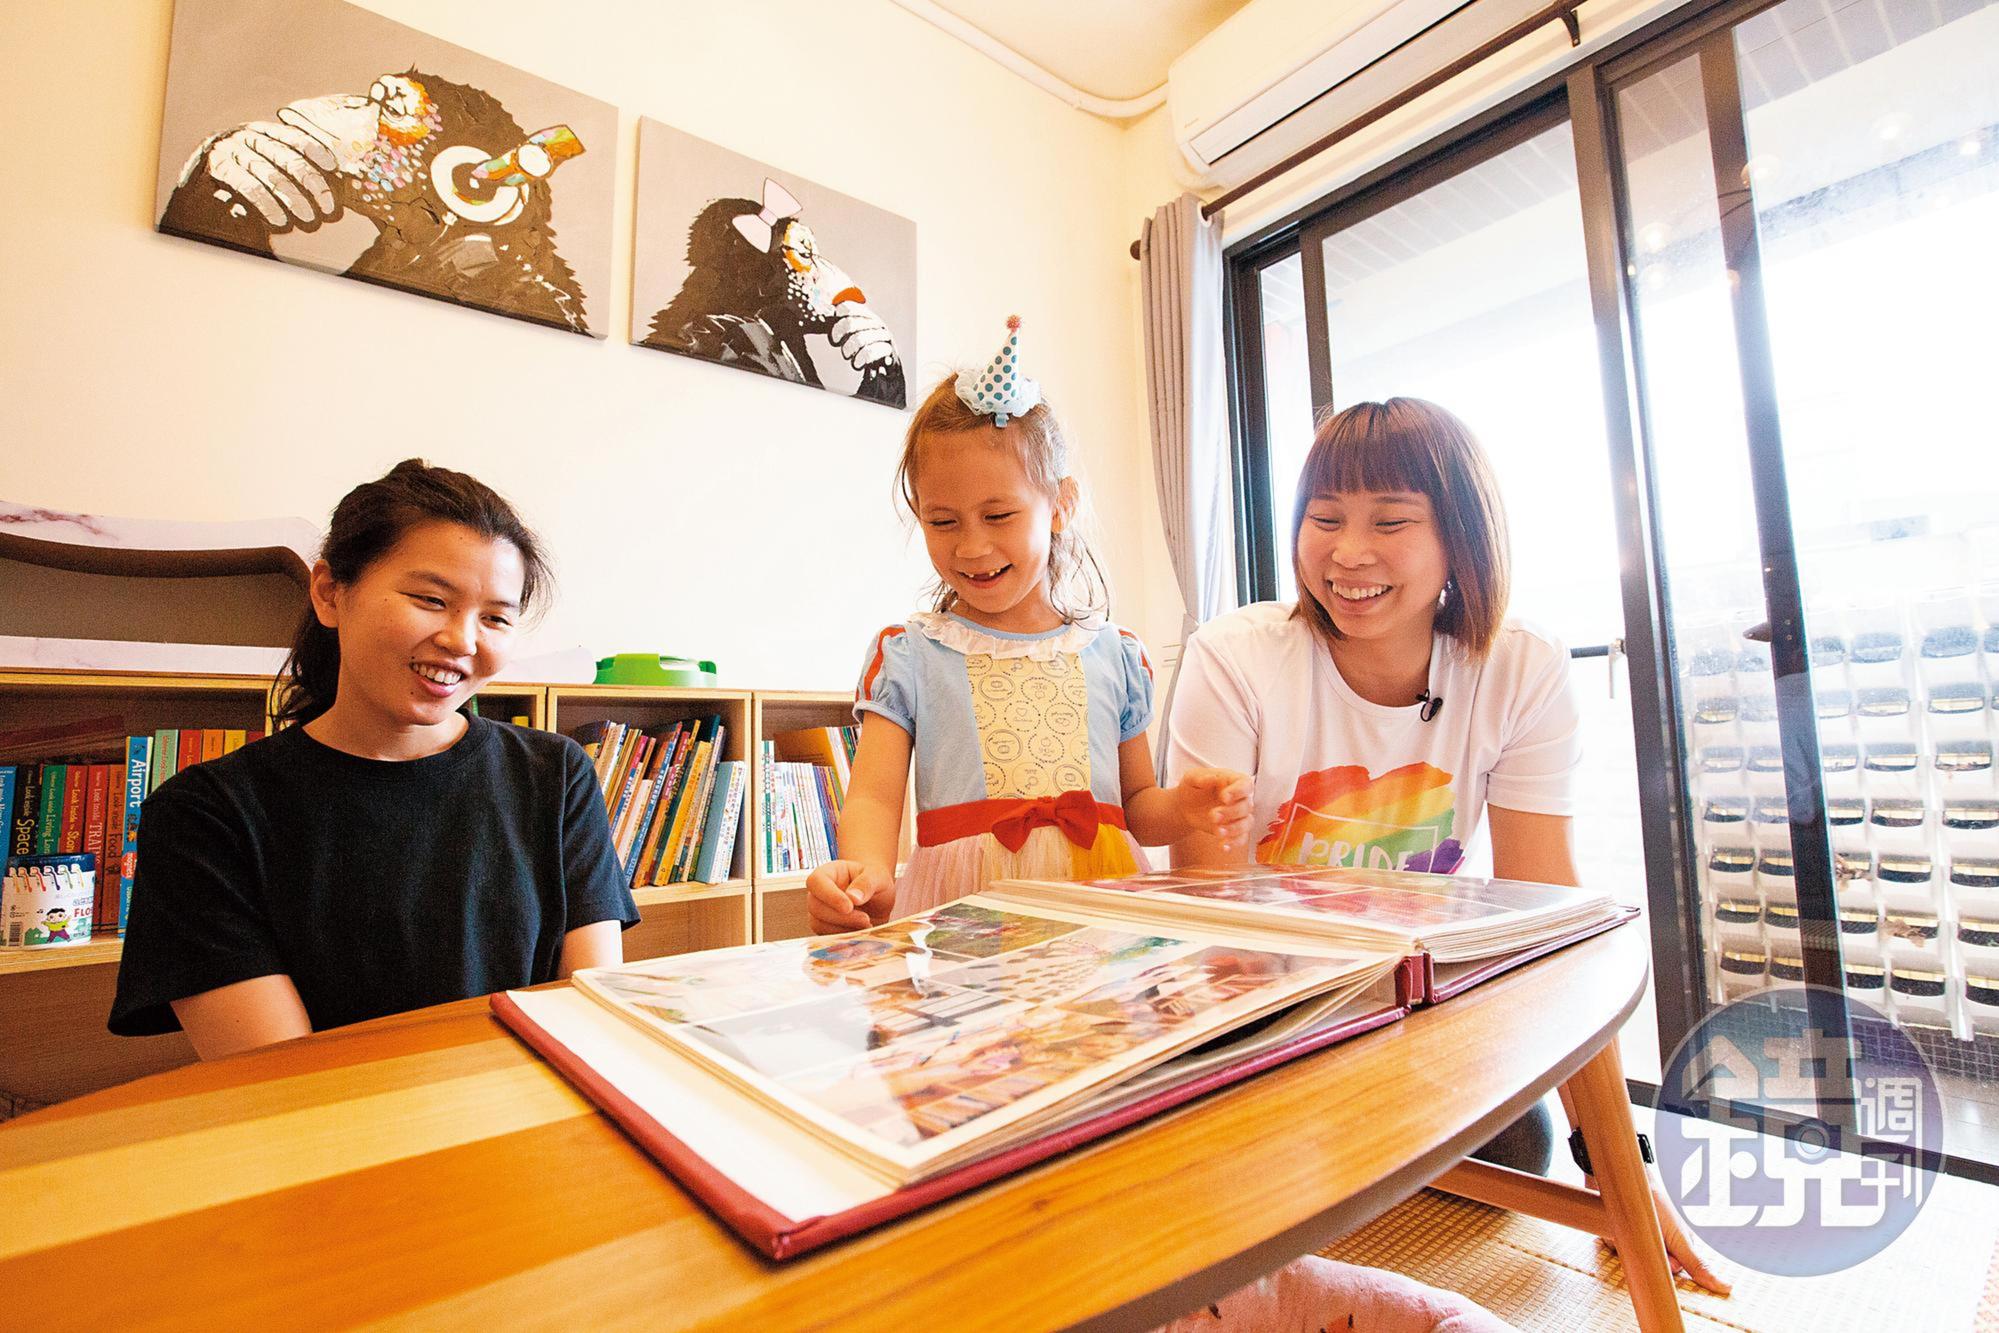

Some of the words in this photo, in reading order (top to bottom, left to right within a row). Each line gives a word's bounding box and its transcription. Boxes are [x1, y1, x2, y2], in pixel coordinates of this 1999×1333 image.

[127, 758, 146, 808] Airport
[16, 818, 35, 855] Space
[42, 814, 56, 838] Living
[44, 839, 55, 855] Lon
[66, 831, 80, 853] Ston
[108, 833, 123, 859] Food
[1297, 831, 1413, 871] PRIDE
